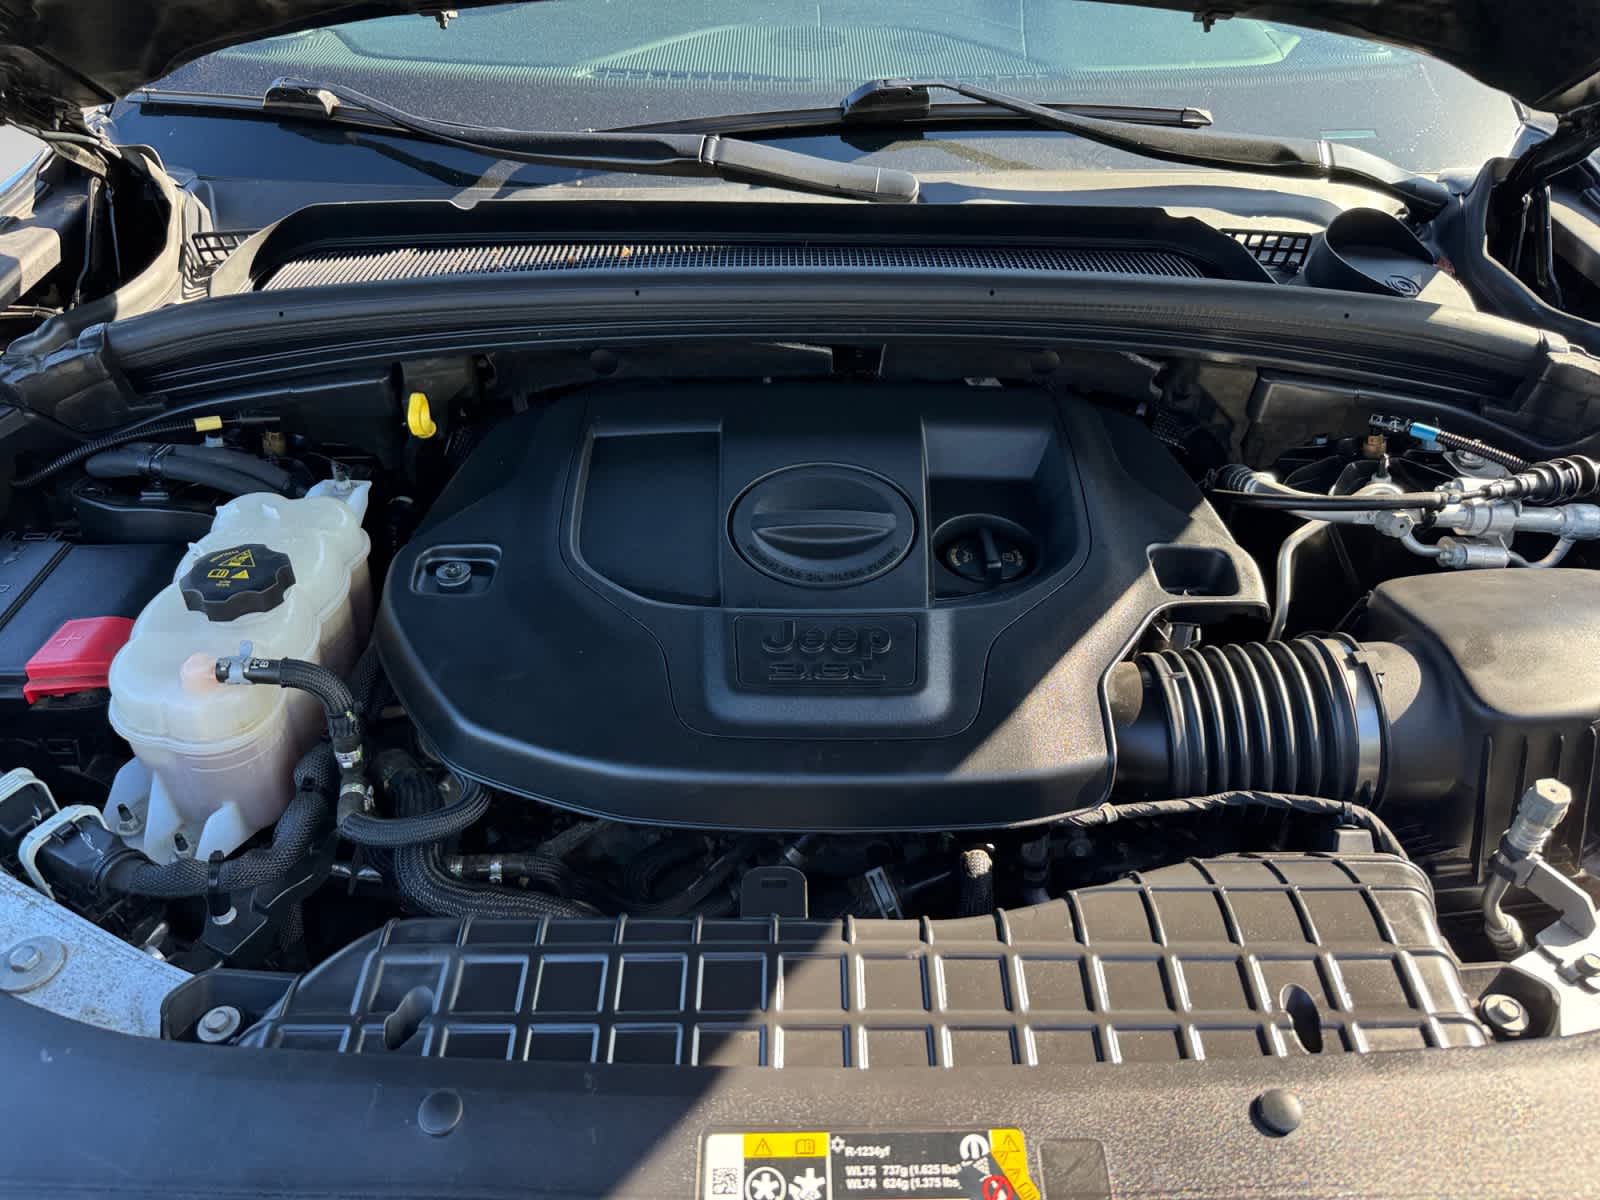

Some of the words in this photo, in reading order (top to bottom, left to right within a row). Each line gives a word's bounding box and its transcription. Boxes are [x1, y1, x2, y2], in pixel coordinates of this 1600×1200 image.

[761, 618, 892, 660] Jeep
[844, 1165, 877, 1176] WL75
[881, 1165, 909, 1178] 737g
[846, 1178, 877, 1189] WL74
[943, 1177, 963, 1190] lbs
